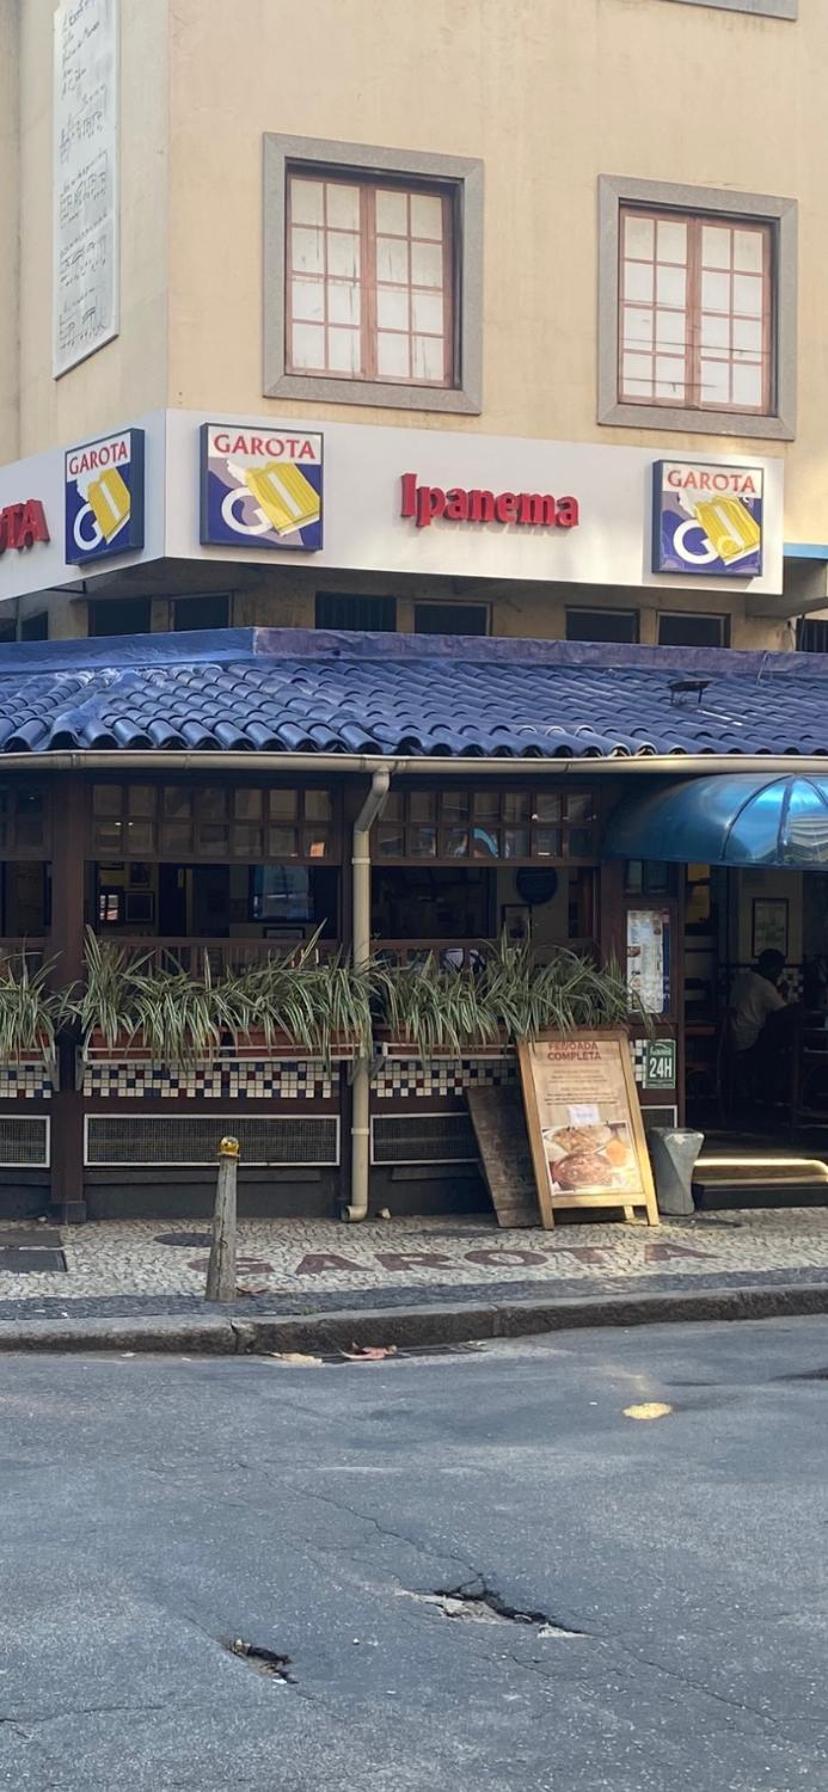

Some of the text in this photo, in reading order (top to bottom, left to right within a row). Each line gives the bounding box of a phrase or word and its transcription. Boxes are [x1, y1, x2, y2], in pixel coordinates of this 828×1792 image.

[69, 441, 128, 475] GAROTA
[214, 433, 316, 460] GAROTA
[667, 469, 756, 494] GAROTA
[400, 473, 580, 529] Ipanema
[547, 1051, 602, 1061] COMPLETA
[548, 1041, 598, 1050] FEIJOADA
[649, 1057, 672, 1078] 24H
[189, 1244, 718, 1274] GAROTA
